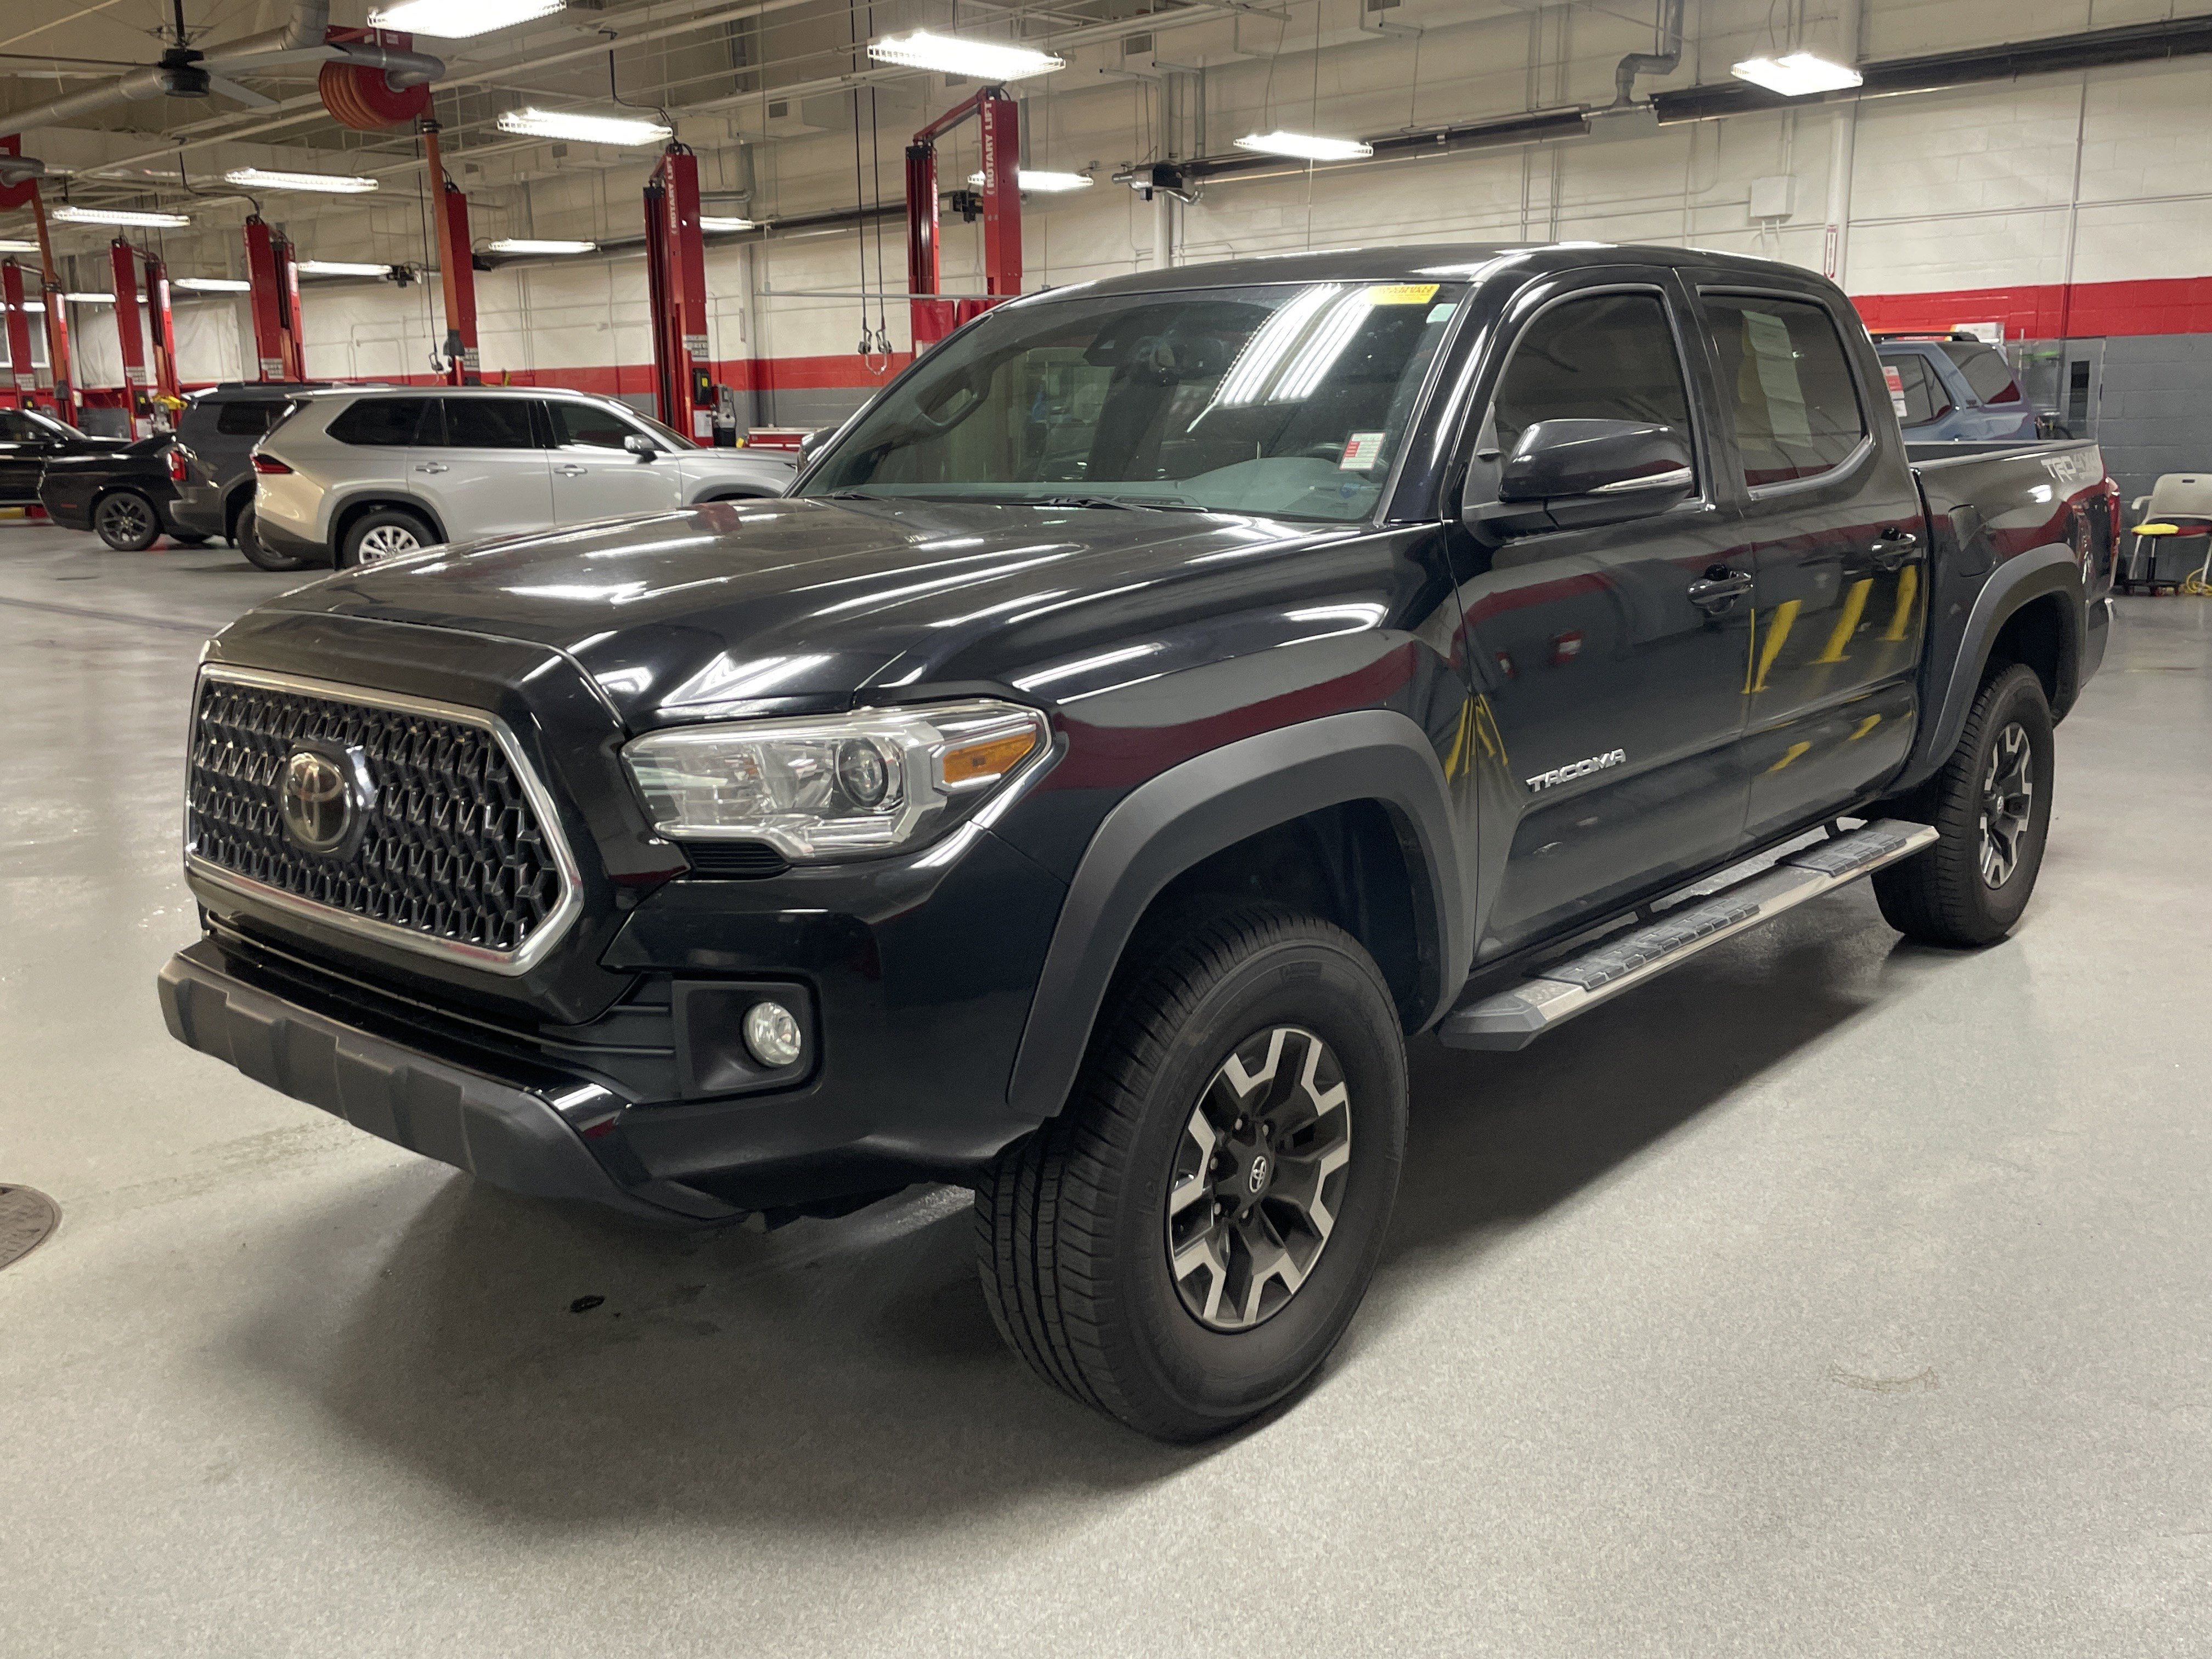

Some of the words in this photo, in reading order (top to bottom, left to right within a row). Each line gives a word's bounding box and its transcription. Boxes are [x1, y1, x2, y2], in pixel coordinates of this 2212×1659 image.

[984, 101, 993, 130] LIFT
[985, 133, 995, 188] ROTARY
[2040, 455, 2076, 483] TRD
[1526, 748, 1627, 792] TACOMA
